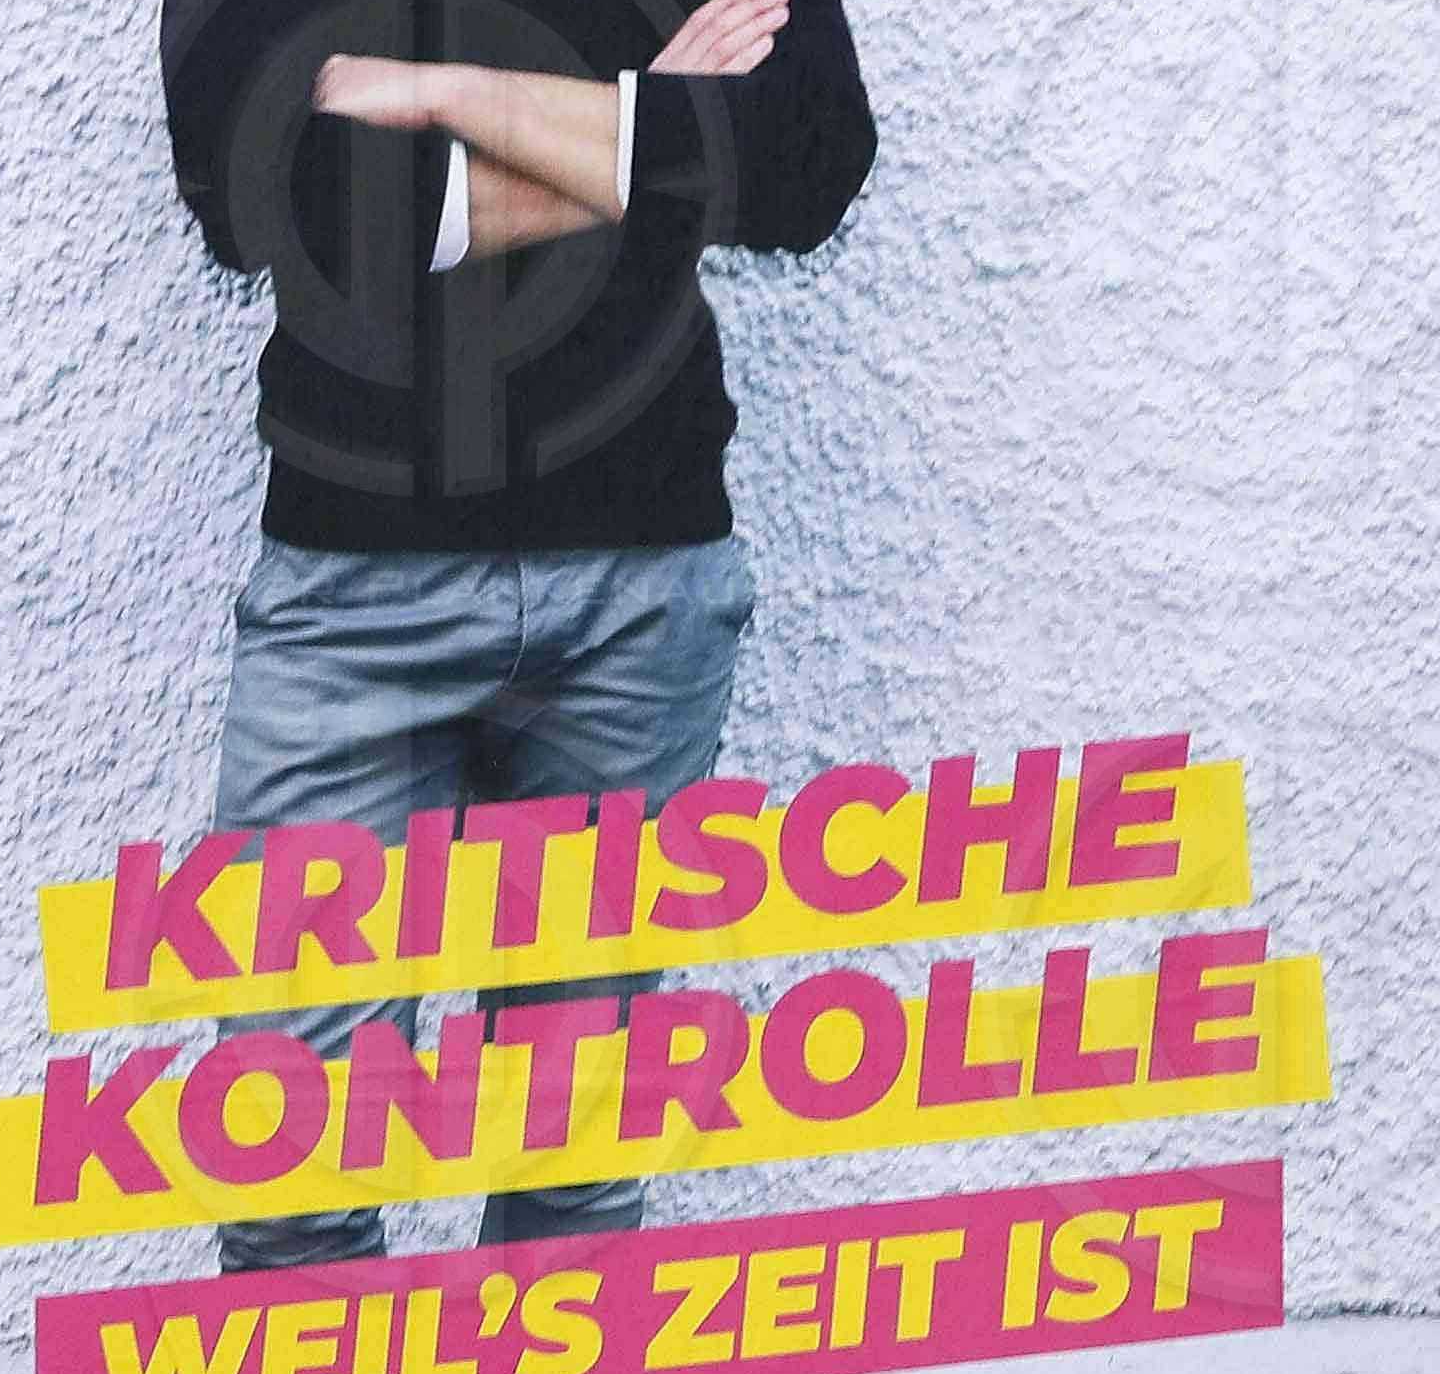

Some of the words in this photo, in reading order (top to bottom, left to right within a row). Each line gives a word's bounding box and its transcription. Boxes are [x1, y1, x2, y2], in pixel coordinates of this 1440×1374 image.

[105, 733, 1192, 993] KRITISCHE
[34, 927, 1271, 1206] KONTROLLE
[644, 1232, 963, 1369] ZEIT
[1000, 1199, 1224, 1329] IST
